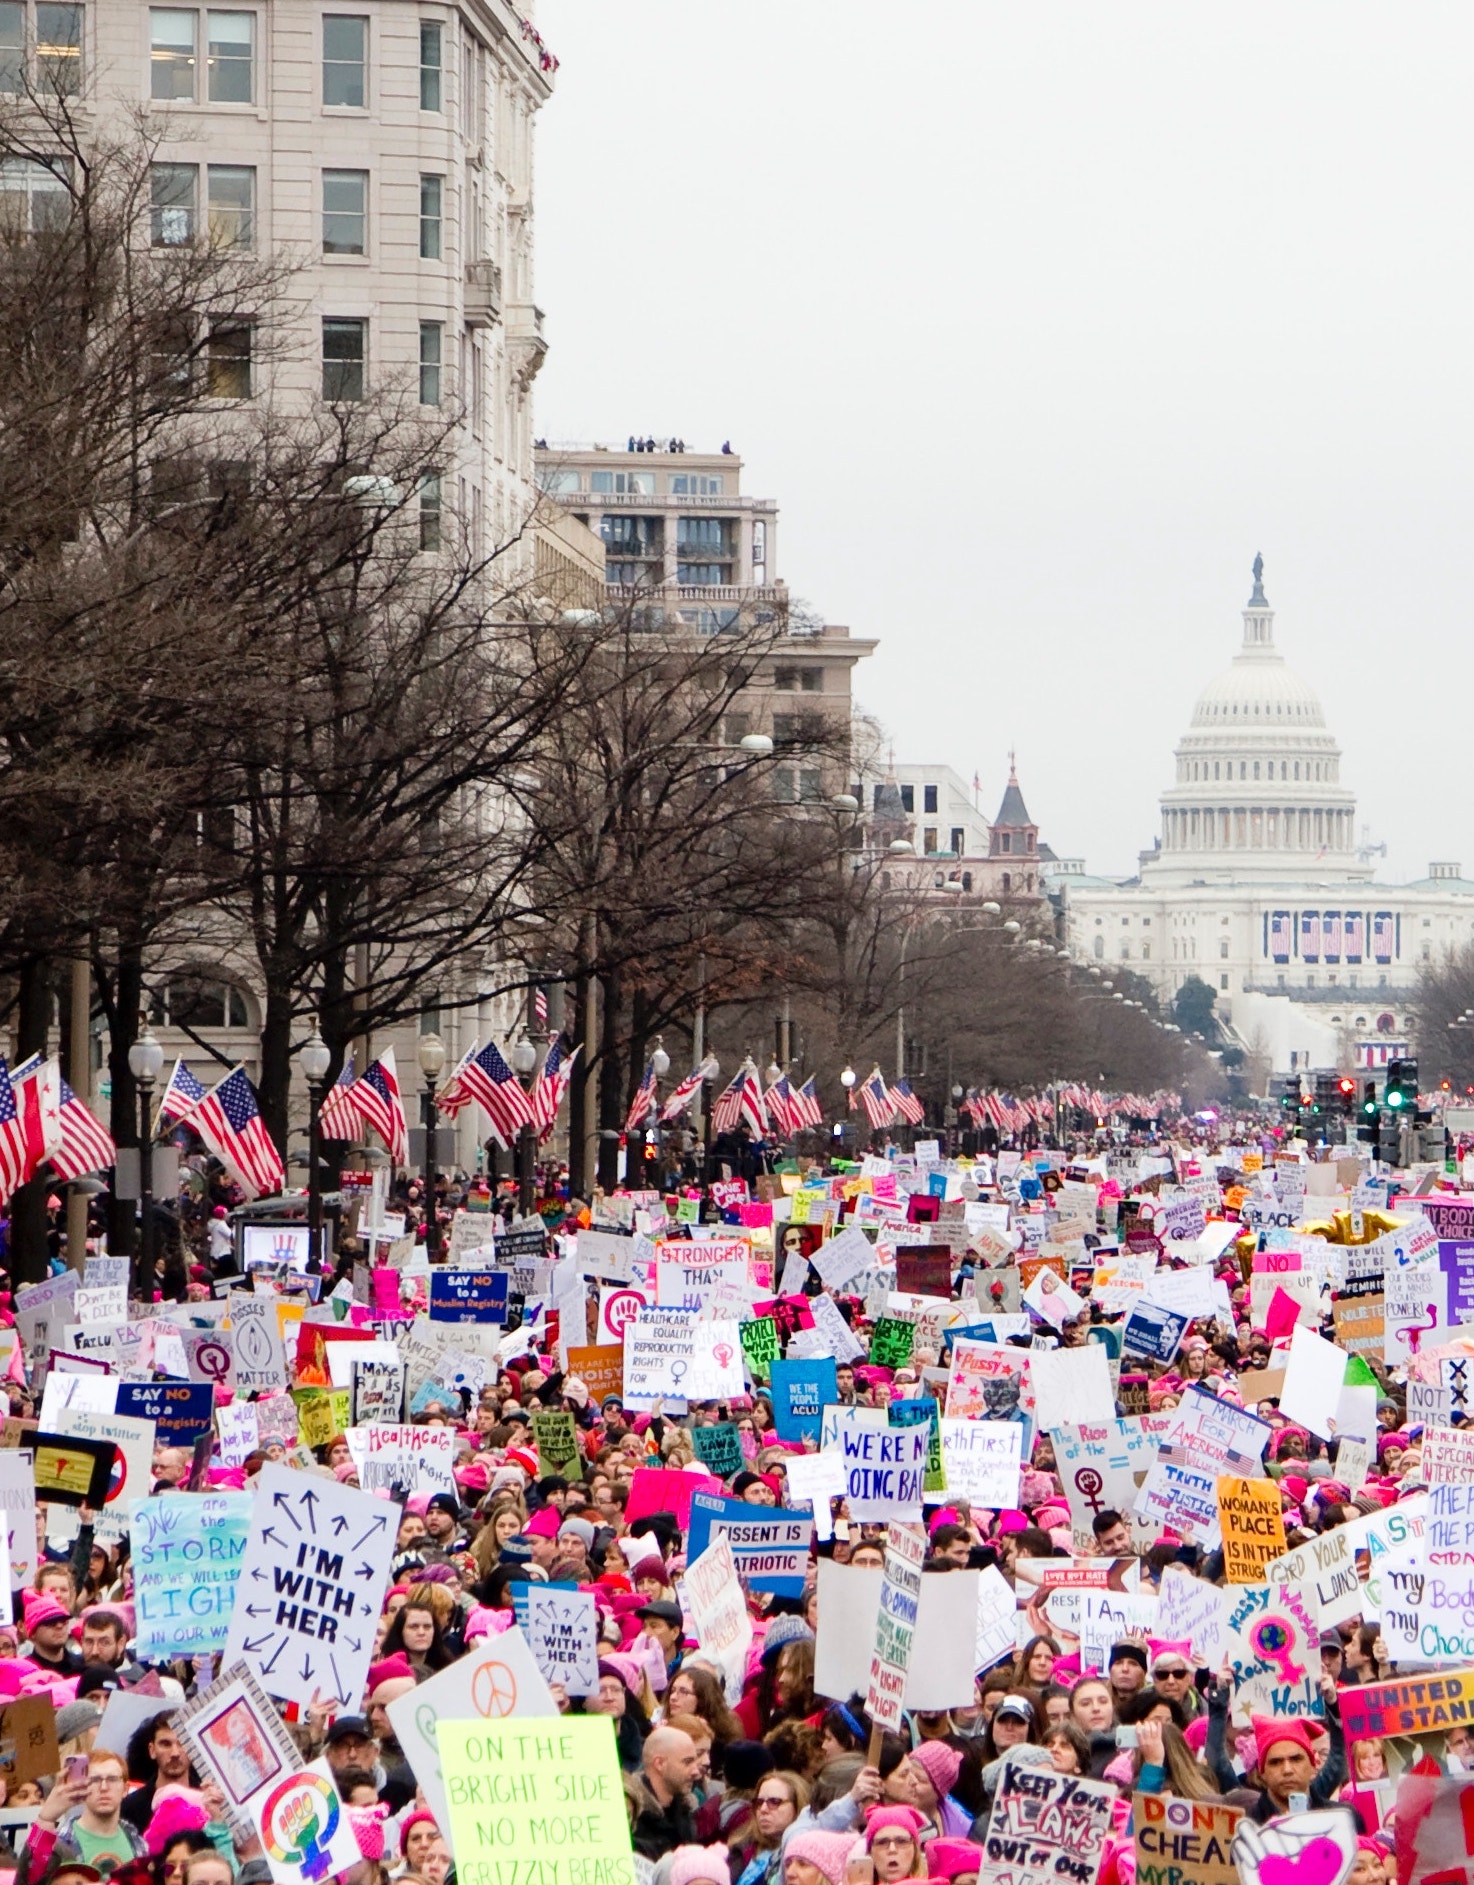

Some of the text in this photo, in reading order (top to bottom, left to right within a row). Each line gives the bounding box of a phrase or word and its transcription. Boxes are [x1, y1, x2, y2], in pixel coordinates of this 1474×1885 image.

[1251, 1212, 1299, 1228] BLACK
[1438, 1224, 1474, 1238] CHOICE
[662, 1247, 743, 1263] STRONGER
[1349, 1258, 1384, 1267] NOT BE
[1266, 1257, 1289, 1272] NO
[447, 1276, 491, 1286] SAY NO
[457, 1289, 467, 1297] to
[639, 1315, 690, 1325] HEALTHCARE
[653, 1328, 694, 1339] EQUALITY
[634, 1342, 693, 1354] REPRODUCTIVE
[632, 1358, 664, 1367] RIGHTS
[237, 1371, 282, 1385] MATTER
[630, 1374, 647, 1383] FOR
[132, 1388, 191, 1401] SAY NO
[789, 1384, 819, 1394] WE THE
[1413, 1385, 1445, 1408] NOT
[790, 1394, 819, 1405] PEOPLE
[145, 1405, 173, 1416] to a
[792, 1405, 819, 1415] ACLU
[1190, 1400, 1257, 1436] I MARCH
[1202, 1422, 1229, 1442] FOR
[1425, 1430, 1459, 1444] WOMEN
[844, 1431, 904, 1461] WE'RE
[1066, 1440, 1141, 1460] of the of
[1423, 1445, 1432, 1457] A
[1165, 1466, 1212, 1493] TRUTH
[1241, 1482, 1249, 1494] A
[695, 1494, 725, 1512] ACLU
[1166, 1488, 1217, 1516] JUSTICE
[1219, 1496, 1279, 1516] WOMAN'S
[1430, 1484, 1459, 1515] THE
[136, 1499, 228, 1539] We are
[201, 1515, 225, 1528] the
[1230, 1516, 1276, 1536] PLACE
[1228, 1542, 1284, 1558] IS IN THE
[1314, 1533, 1347, 1567] YOUR
[297, 1542, 343, 1579] I'M
[141, 1571, 218, 1584] AND WE WILL
[1317, 1566, 1358, 1605] LOINS
[274, 1567, 355, 1615] WITH
[1388, 1571, 1424, 1605] my
[275, 1601, 338, 1644] HER
[551, 1624, 573, 1636] I'M
[151, 1627, 204, 1644] IN OUR
[543, 1636, 581, 1650] WITH
[548, 1650, 577, 1663] HER
[1232, 1656, 1275, 1690] Rock
[1255, 1676, 1325, 1716] the World
[1364, 1679, 1463, 1709] UNITED
[1347, 1712, 1386, 1734] WE
[466, 1736, 574, 1762] ON THE
[449, 1774, 610, 1805] BRIGHT SIDE
[1001, 1763, 1109, 1814] KEEP YOUR
[477, 1816, 602, 1847] NO MORE
[1004, 1797, 1106, 1857] LAWS
[463, 1857, 632, 1885] GRIZZLY BEARS
